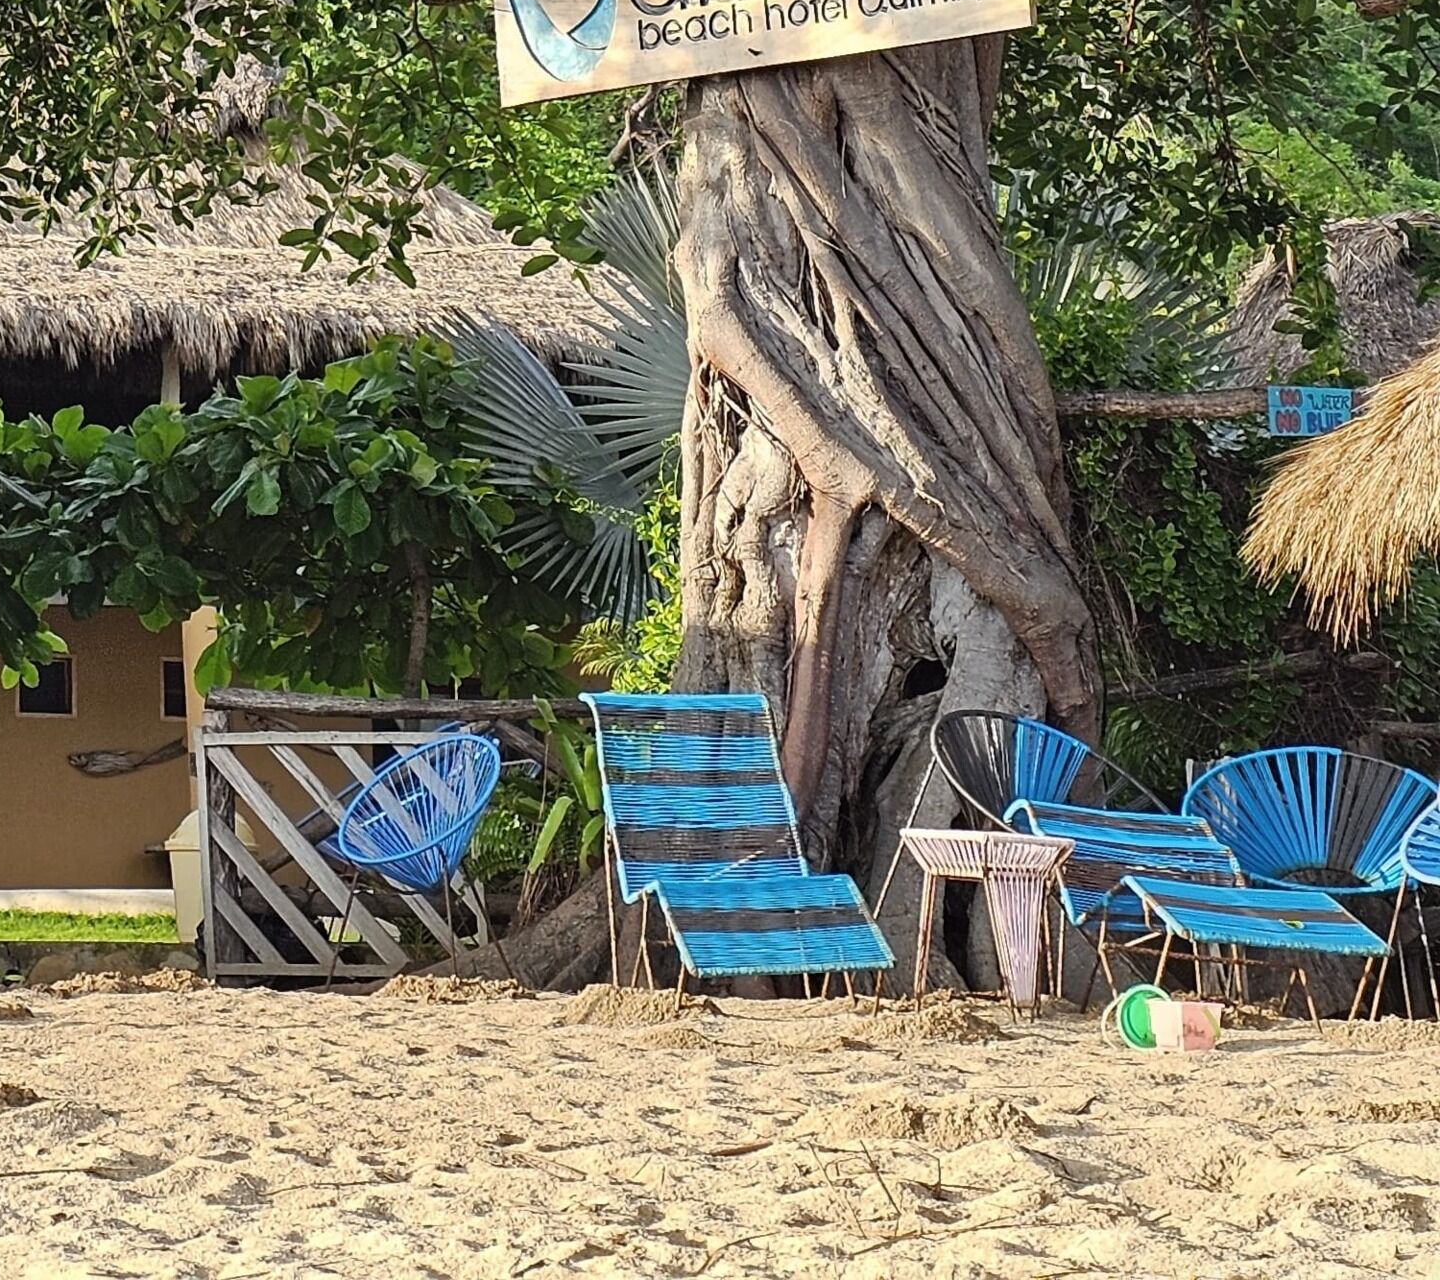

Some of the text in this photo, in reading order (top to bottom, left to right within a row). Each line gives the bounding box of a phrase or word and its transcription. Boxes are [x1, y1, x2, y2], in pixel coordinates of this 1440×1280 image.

[637, 3, 753, 51] beach
[1280, 388, 1303, 408] NO
[1275, 409, 1301, 433] NO
